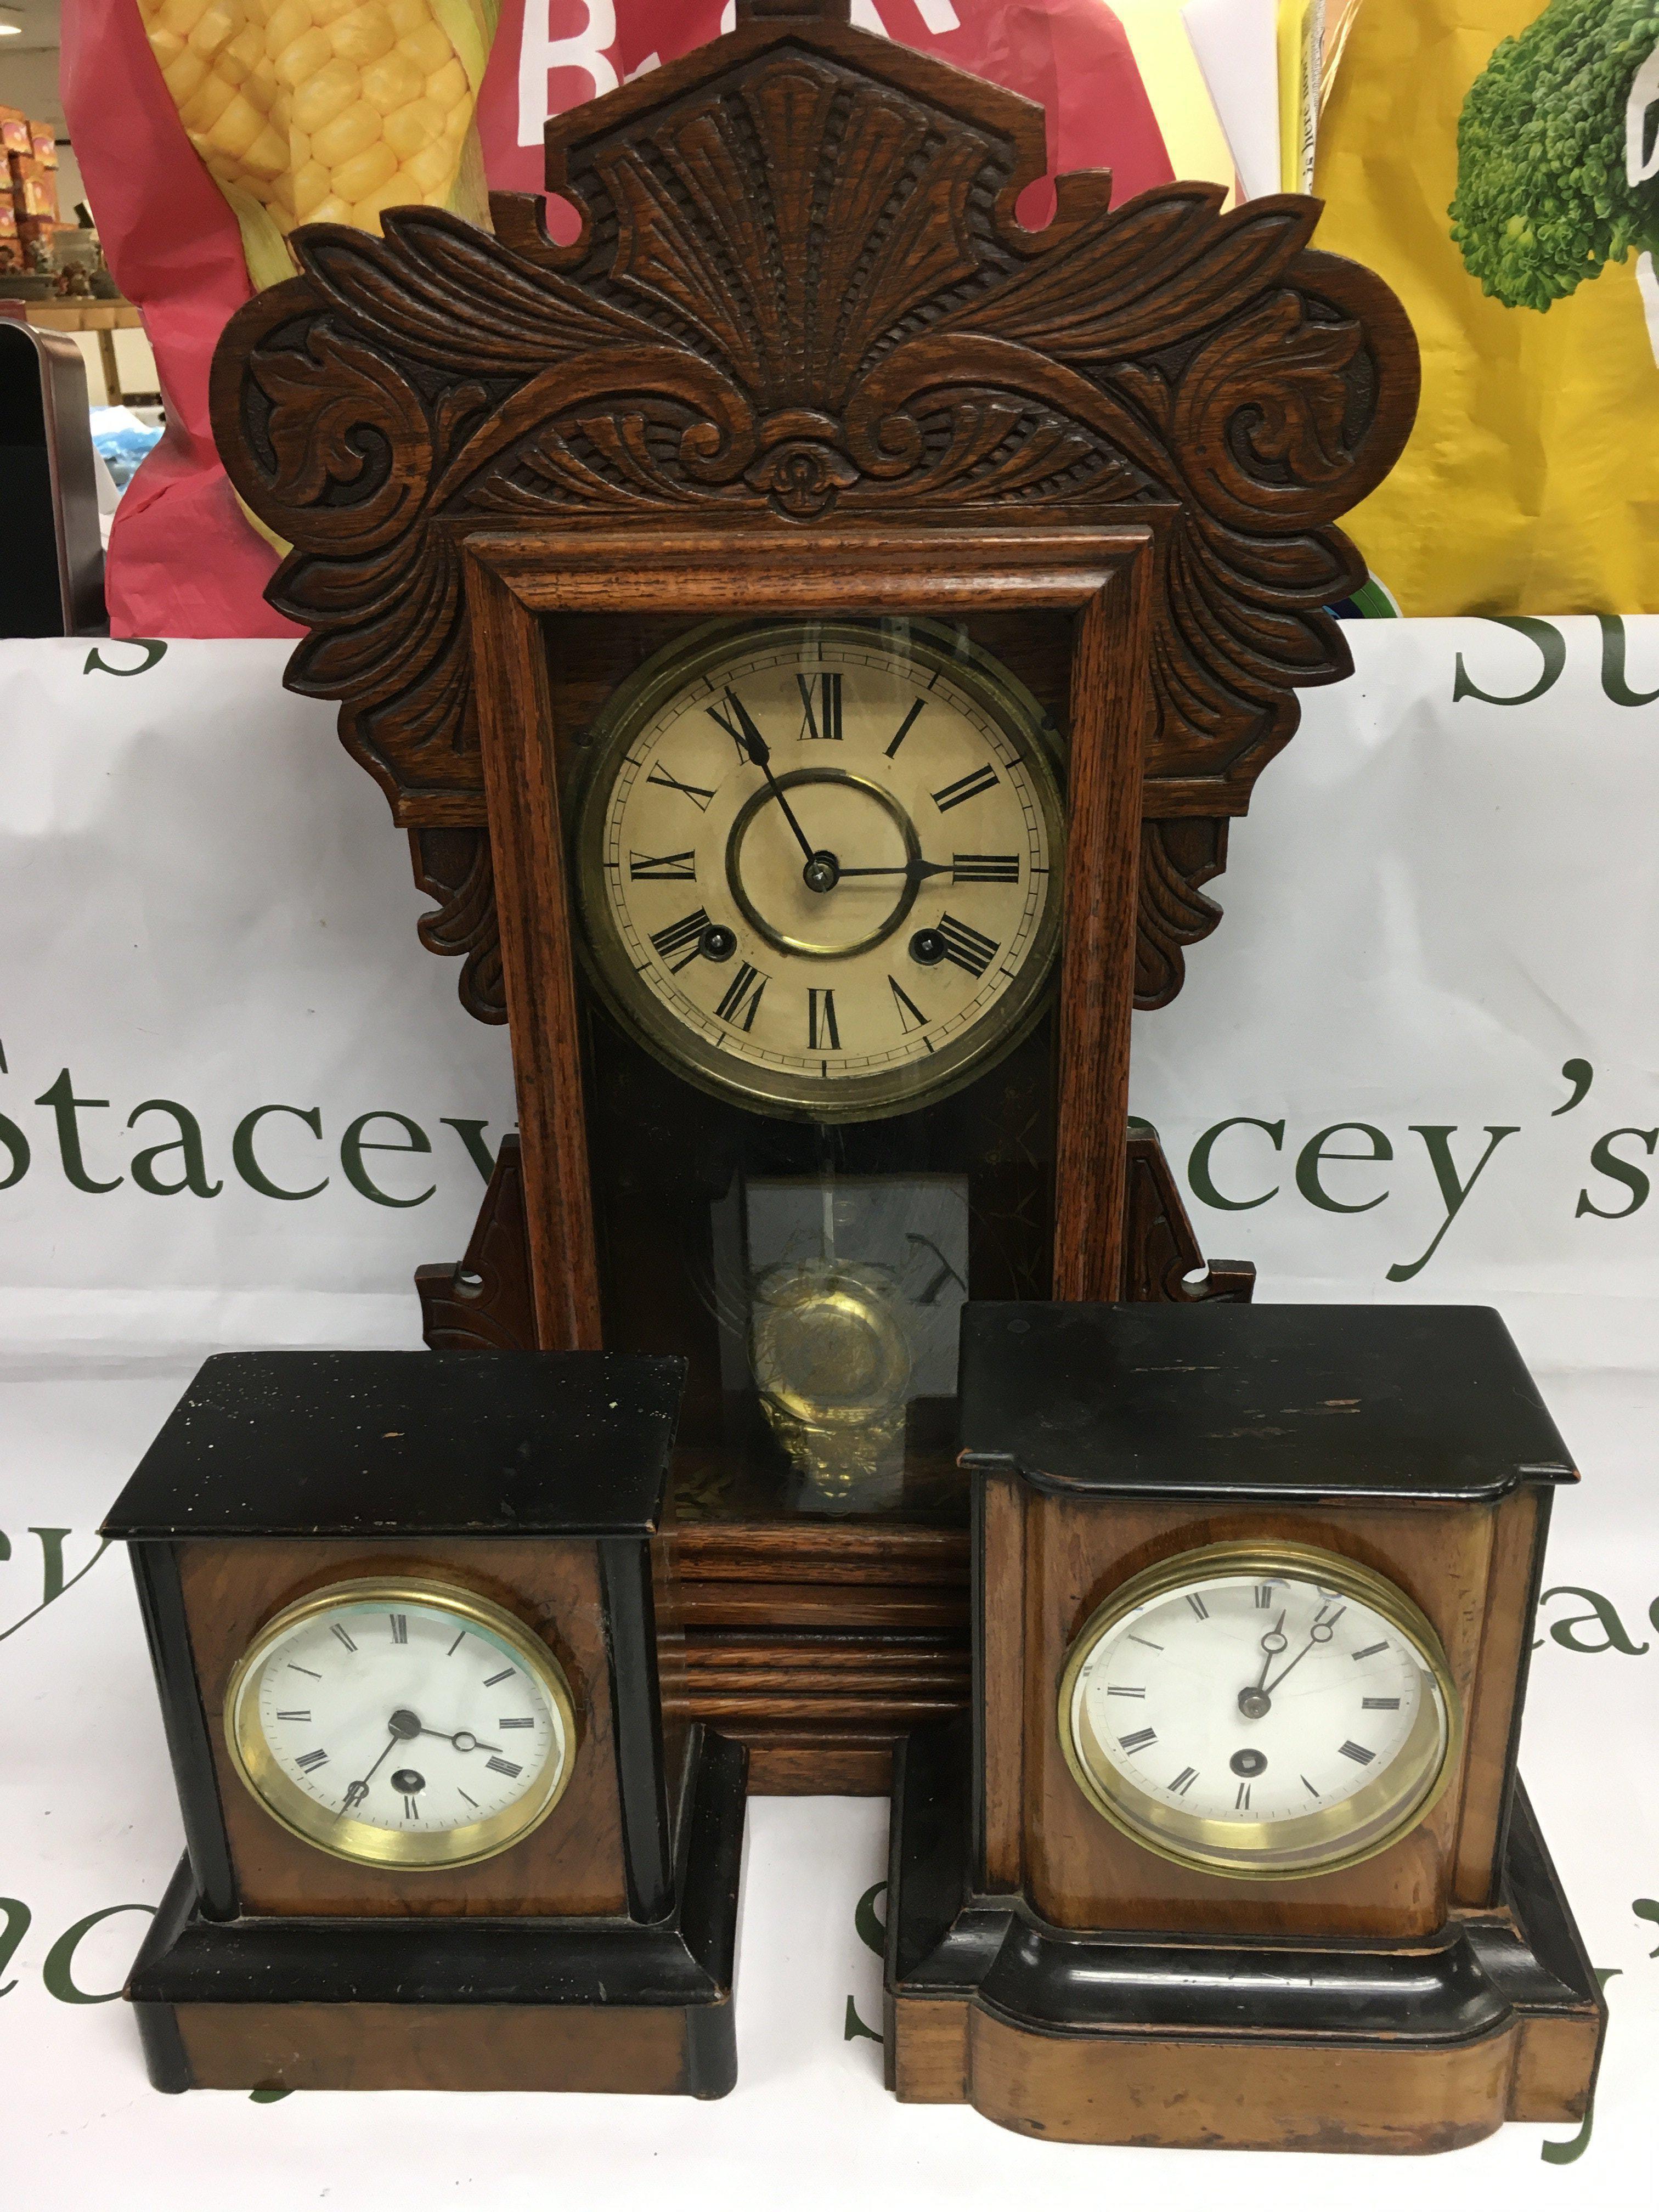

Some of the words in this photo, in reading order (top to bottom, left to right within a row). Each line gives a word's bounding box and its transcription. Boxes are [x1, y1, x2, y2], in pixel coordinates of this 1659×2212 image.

[797, 673, 843, 740] XII
[883, 697, 928, 759] I
[647, 761, 716, 812] X
[929, 763, 1000, 812] II
[630, 849, 697, 882] IX
[952, 853, 1019, 885] III
[648, 905, 713, 976] VIII
[713, 960, 772, 1034] VII
[888, 974, 932, 1035] V
[808, 988, 842, 1050] VI
[1351, 1640, 1390, 1661] II
[483, 1667, 517, 1688] II
[1362, 1697, 1401, 1710] III
[499, 1717, 534, 1729] III
[1116, 1726, 1160, 1757] VIII
[1338, 1740, 1377, 1766] IIII
[295, 1748, 331, 1775] VIII
[485, 1755, 523, 1779] IIII
[1167, 1767, 1200, 1797] VII
[1235, 1782, 1251, 1810] VI
